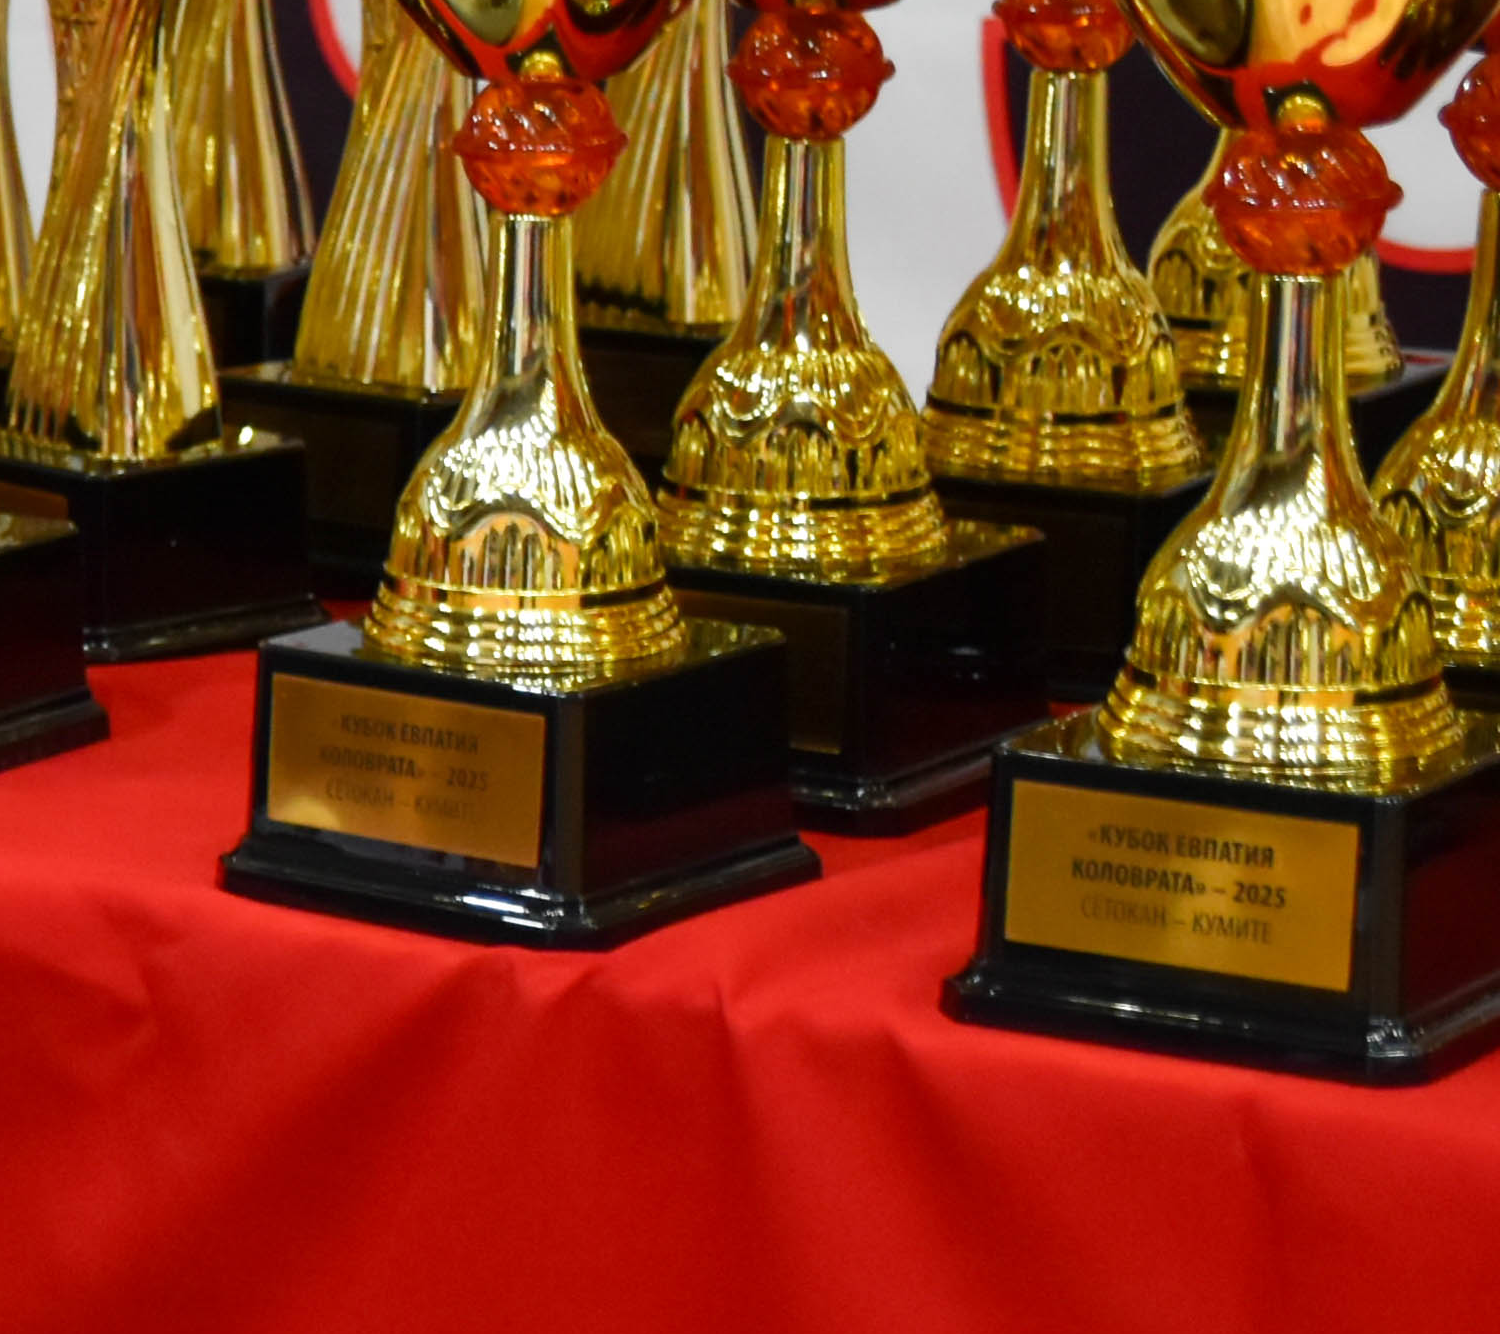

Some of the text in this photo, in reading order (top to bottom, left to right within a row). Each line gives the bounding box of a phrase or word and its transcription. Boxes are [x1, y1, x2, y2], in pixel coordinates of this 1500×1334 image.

[1175, 834, 1275, 869] ЕВПАТИЯ
[1232, 880, 1287, 910] 2025
[1080, 894, 1168, 930] СЕТОКАН
[1191, 913, 1273, 946] КУМИТЕ
